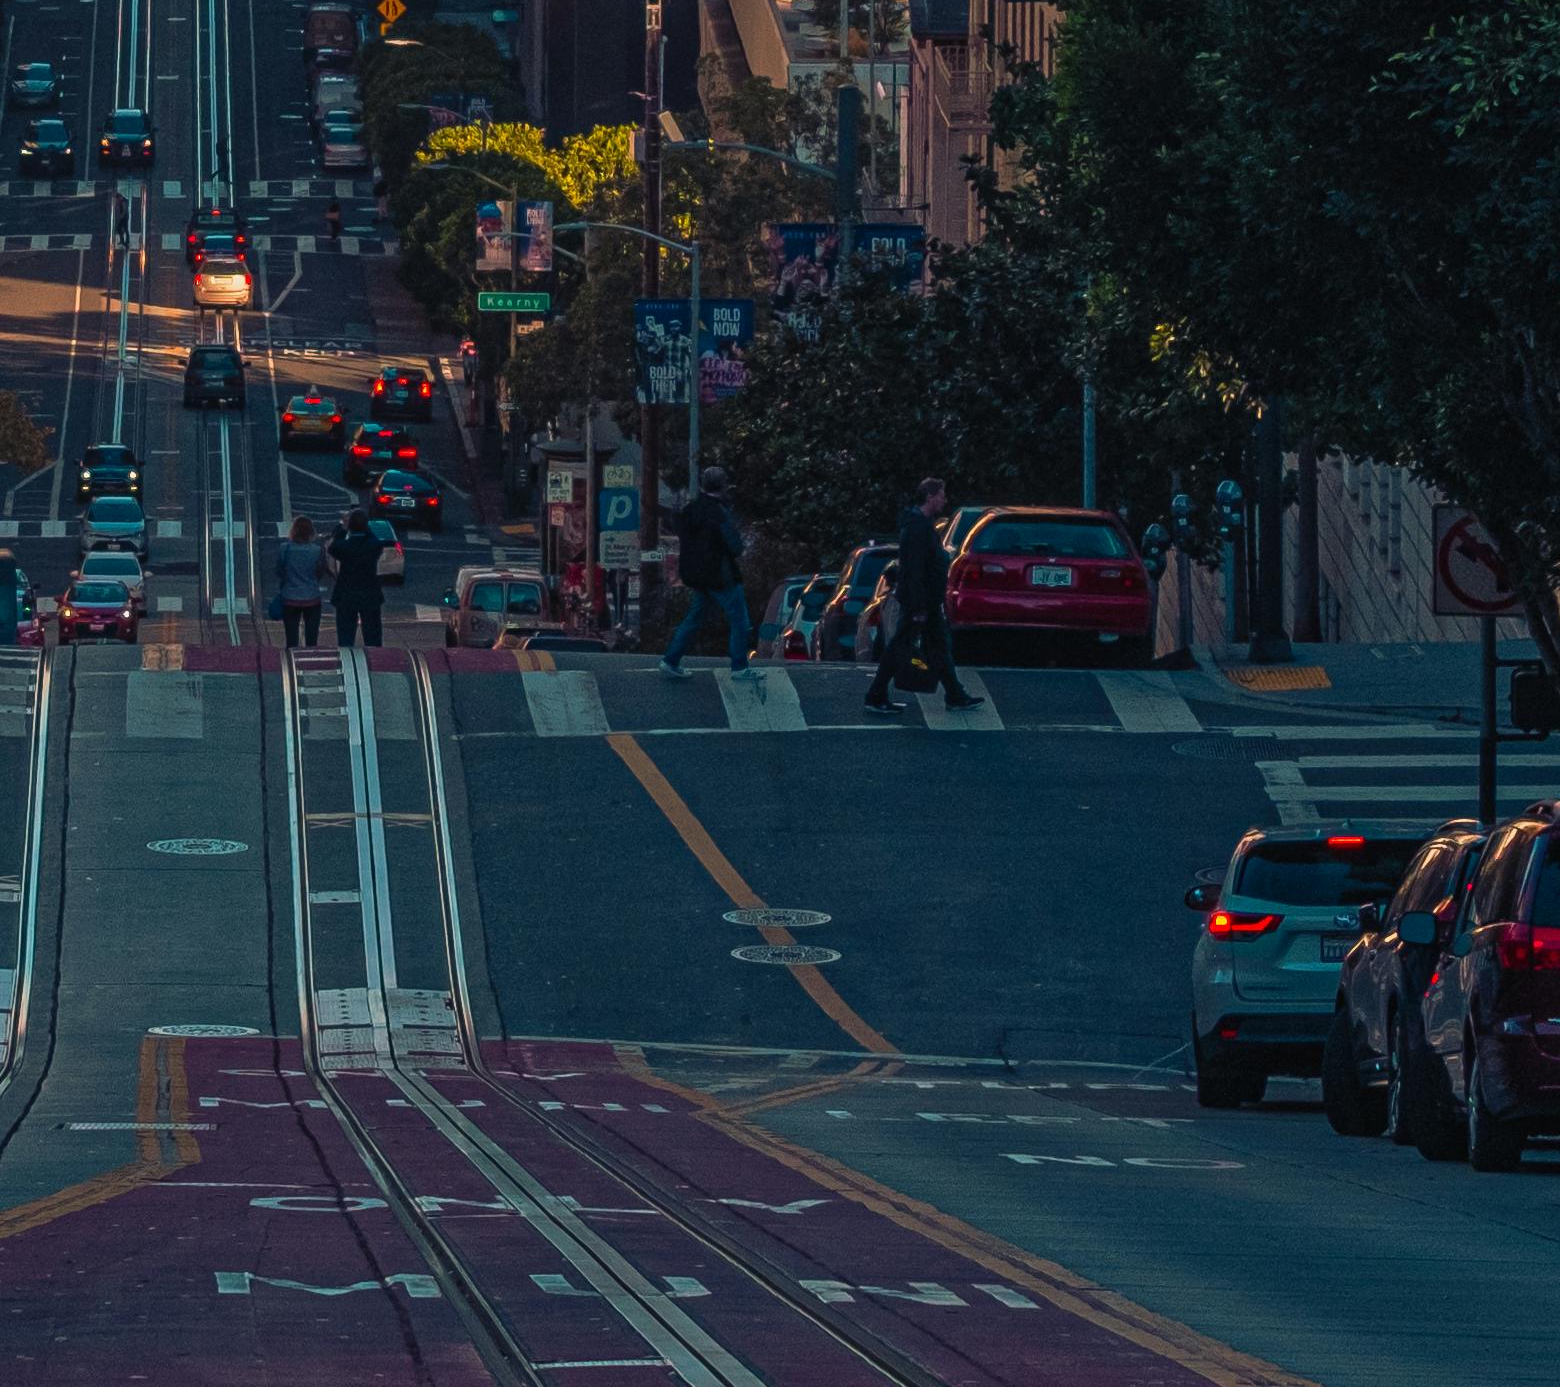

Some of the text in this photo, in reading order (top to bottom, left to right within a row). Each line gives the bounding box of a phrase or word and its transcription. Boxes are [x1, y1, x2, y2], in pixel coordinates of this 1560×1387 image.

[487, 297, 541, 309] Kearny
[713, 308, 740, 322] BOLD
[713, 322, 740, 337] NOW
[649, 365, 676, 379] BOLD
[998, 1152, 1246, 1170] NO
[249, 1195, 834, 1215] ONLY
[214, 1270, 1043, 1310] MUNI
